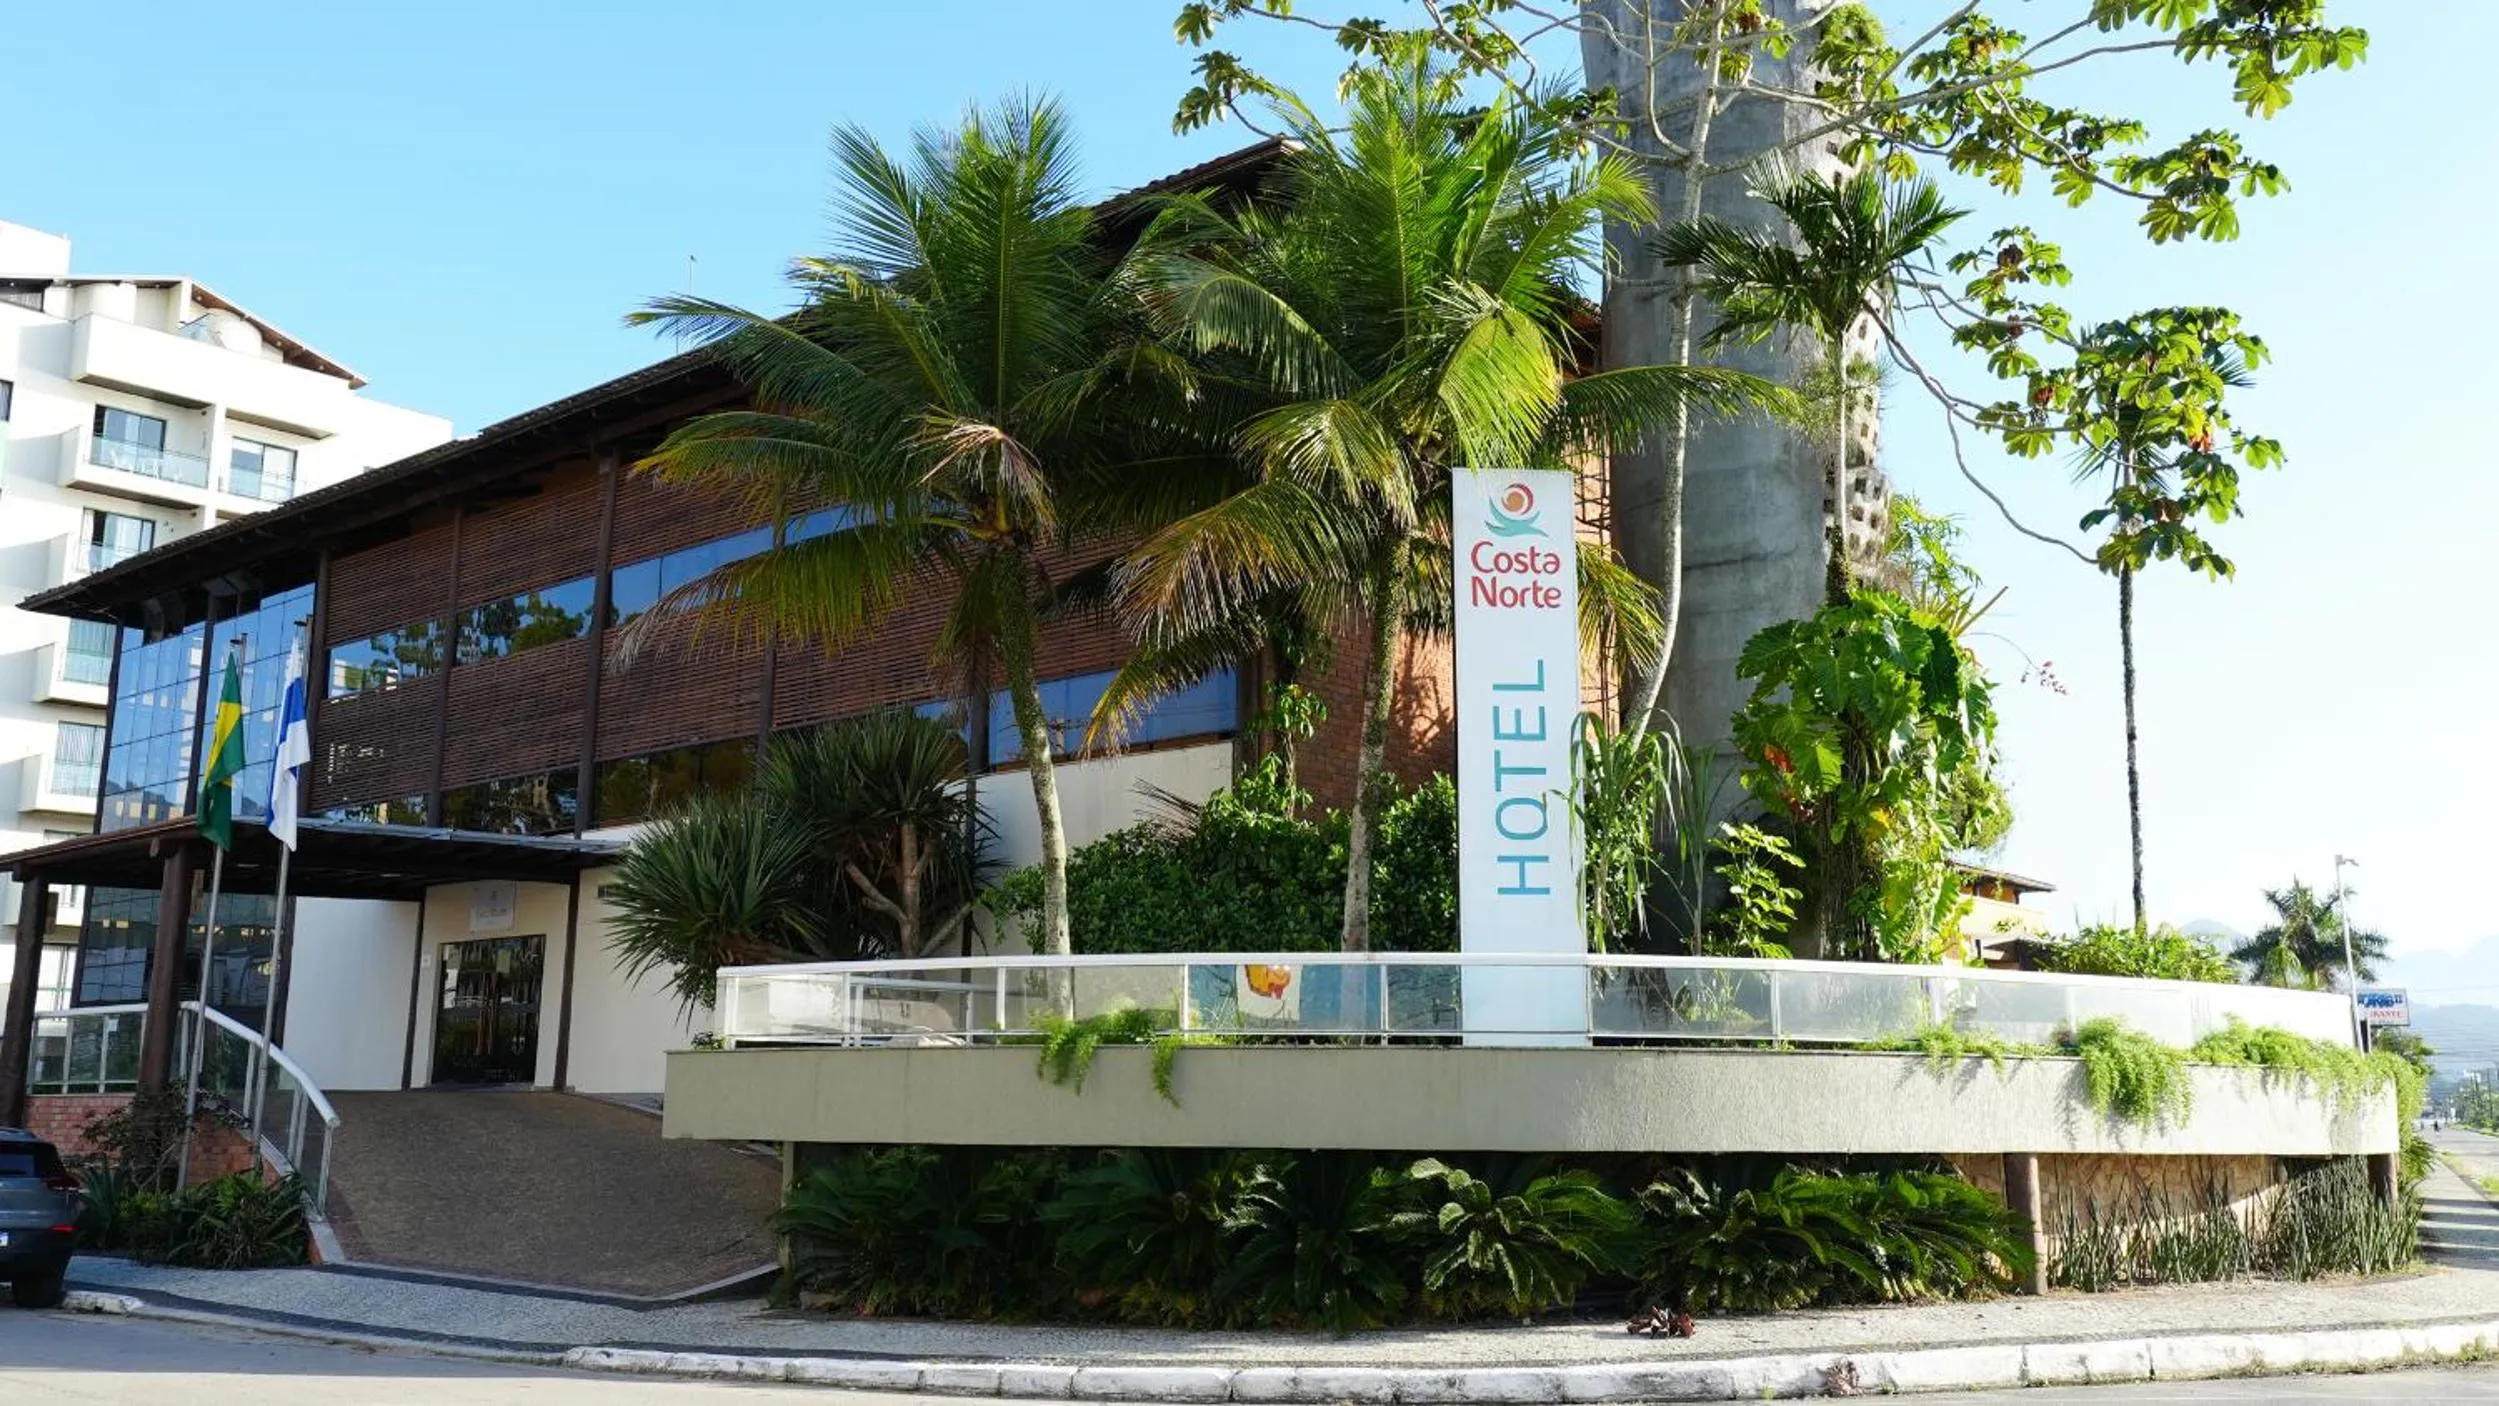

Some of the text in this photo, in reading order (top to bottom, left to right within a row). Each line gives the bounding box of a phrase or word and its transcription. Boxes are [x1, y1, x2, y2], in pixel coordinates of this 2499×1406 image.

[1471, 541, 1560, 574] Costa
[1471, 576, 1561, 608] Norte
[1492, 659, 1550, 895] HOTEL
